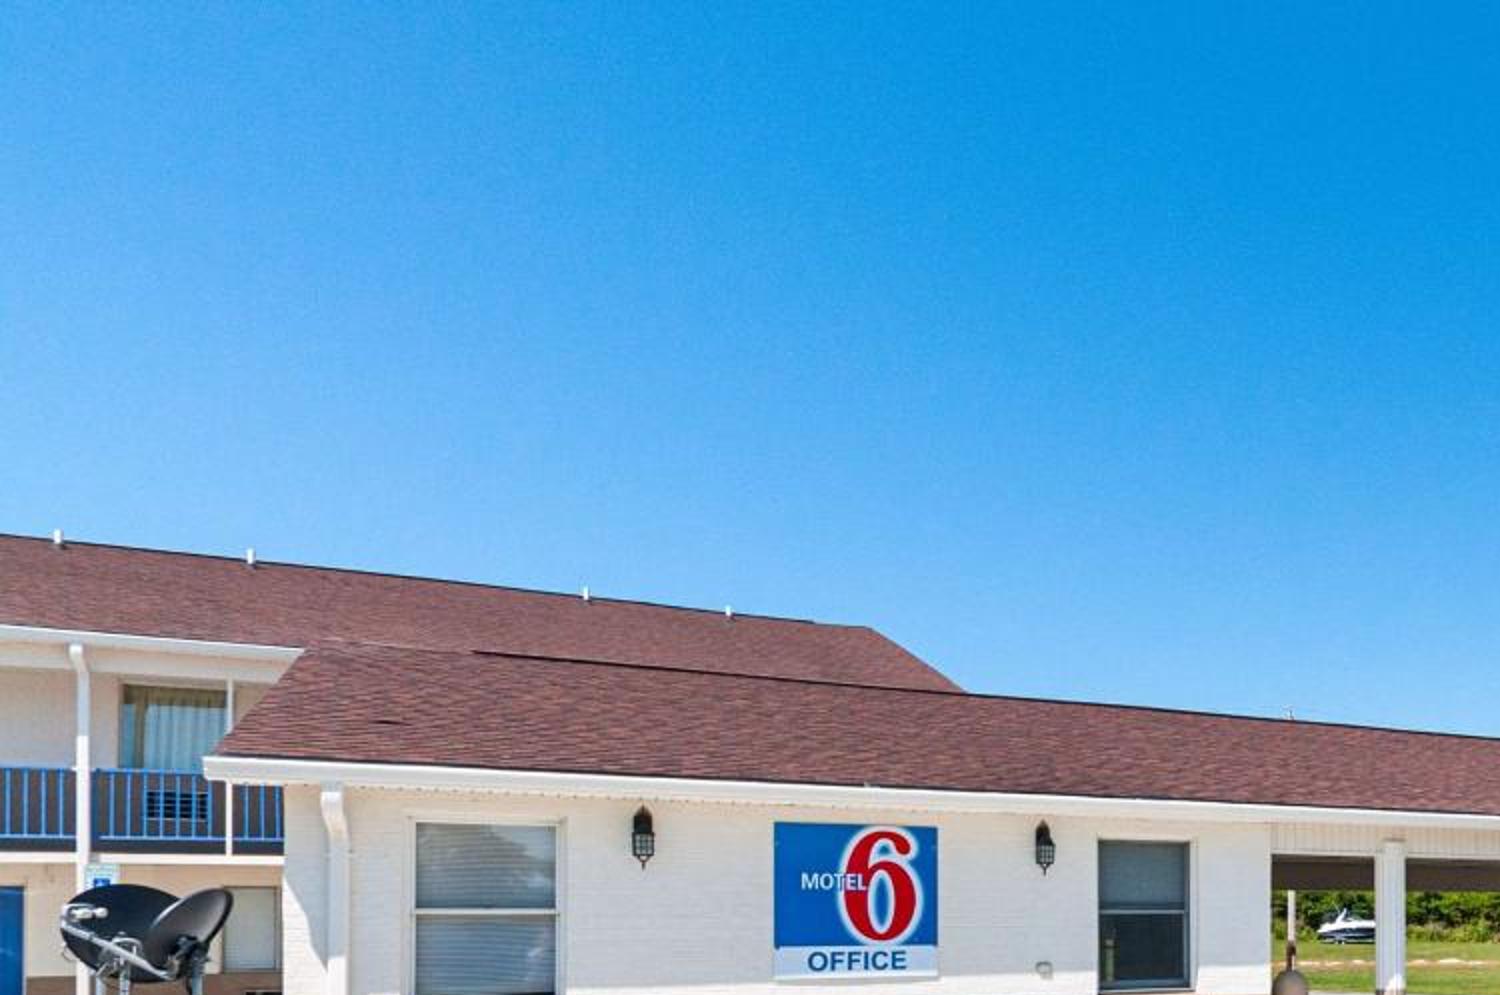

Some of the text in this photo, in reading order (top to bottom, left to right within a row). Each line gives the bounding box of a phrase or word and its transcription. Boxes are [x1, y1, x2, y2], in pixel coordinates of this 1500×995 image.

[800, 828, 919, 943] MOTEL 6
[807, 950, 908, 972] OFFICE
